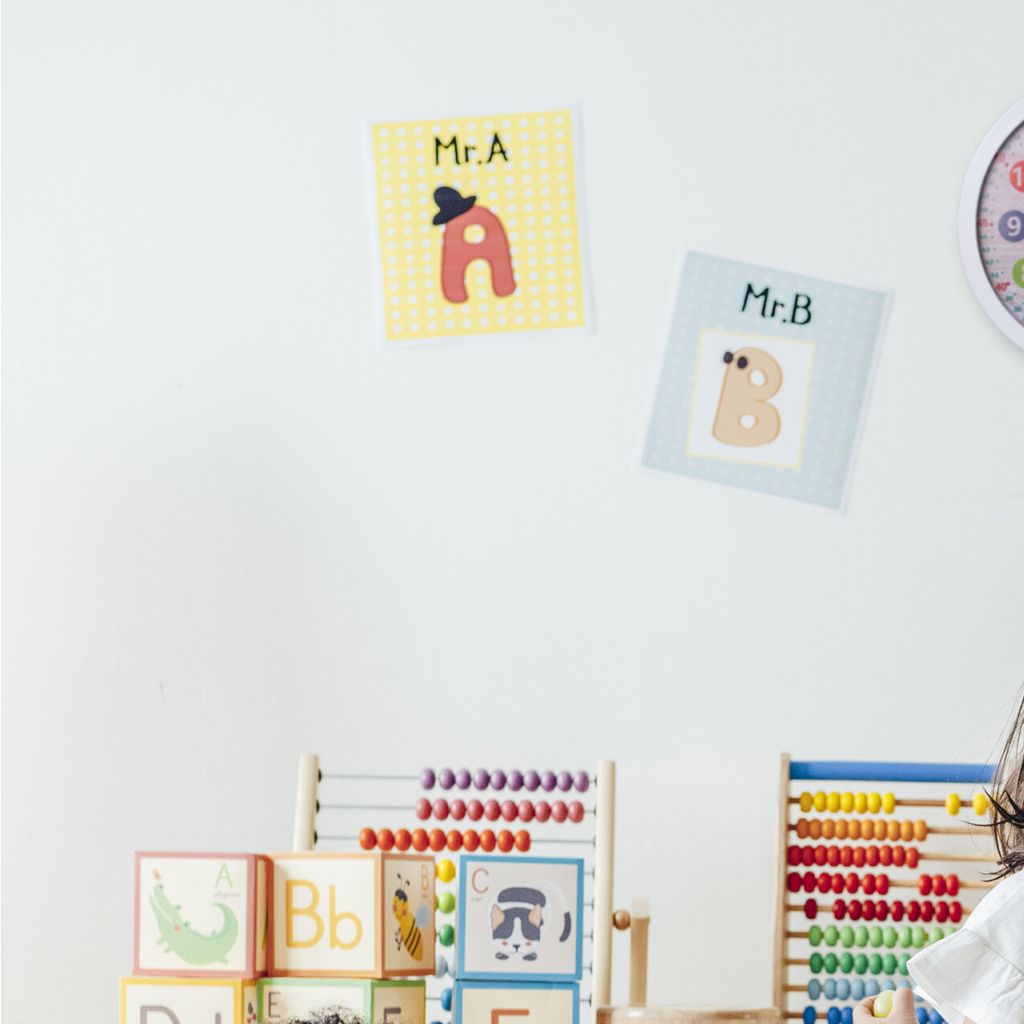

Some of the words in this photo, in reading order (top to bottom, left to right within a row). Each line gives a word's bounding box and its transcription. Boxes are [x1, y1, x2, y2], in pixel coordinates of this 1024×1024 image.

[435, 133, 508, 166] Mr.A
[1007, 214, 1022, 236] 9
[441, 205, 517, 304] A
[740, 283, 811, 326] Mr.B
[711, 346, 784, 448] B
[214, 862, 233, 889] A
[471, 867, 489, 894] C
[285, 879, 364, 951] Bb
[268, 991, 281, 1018] E
